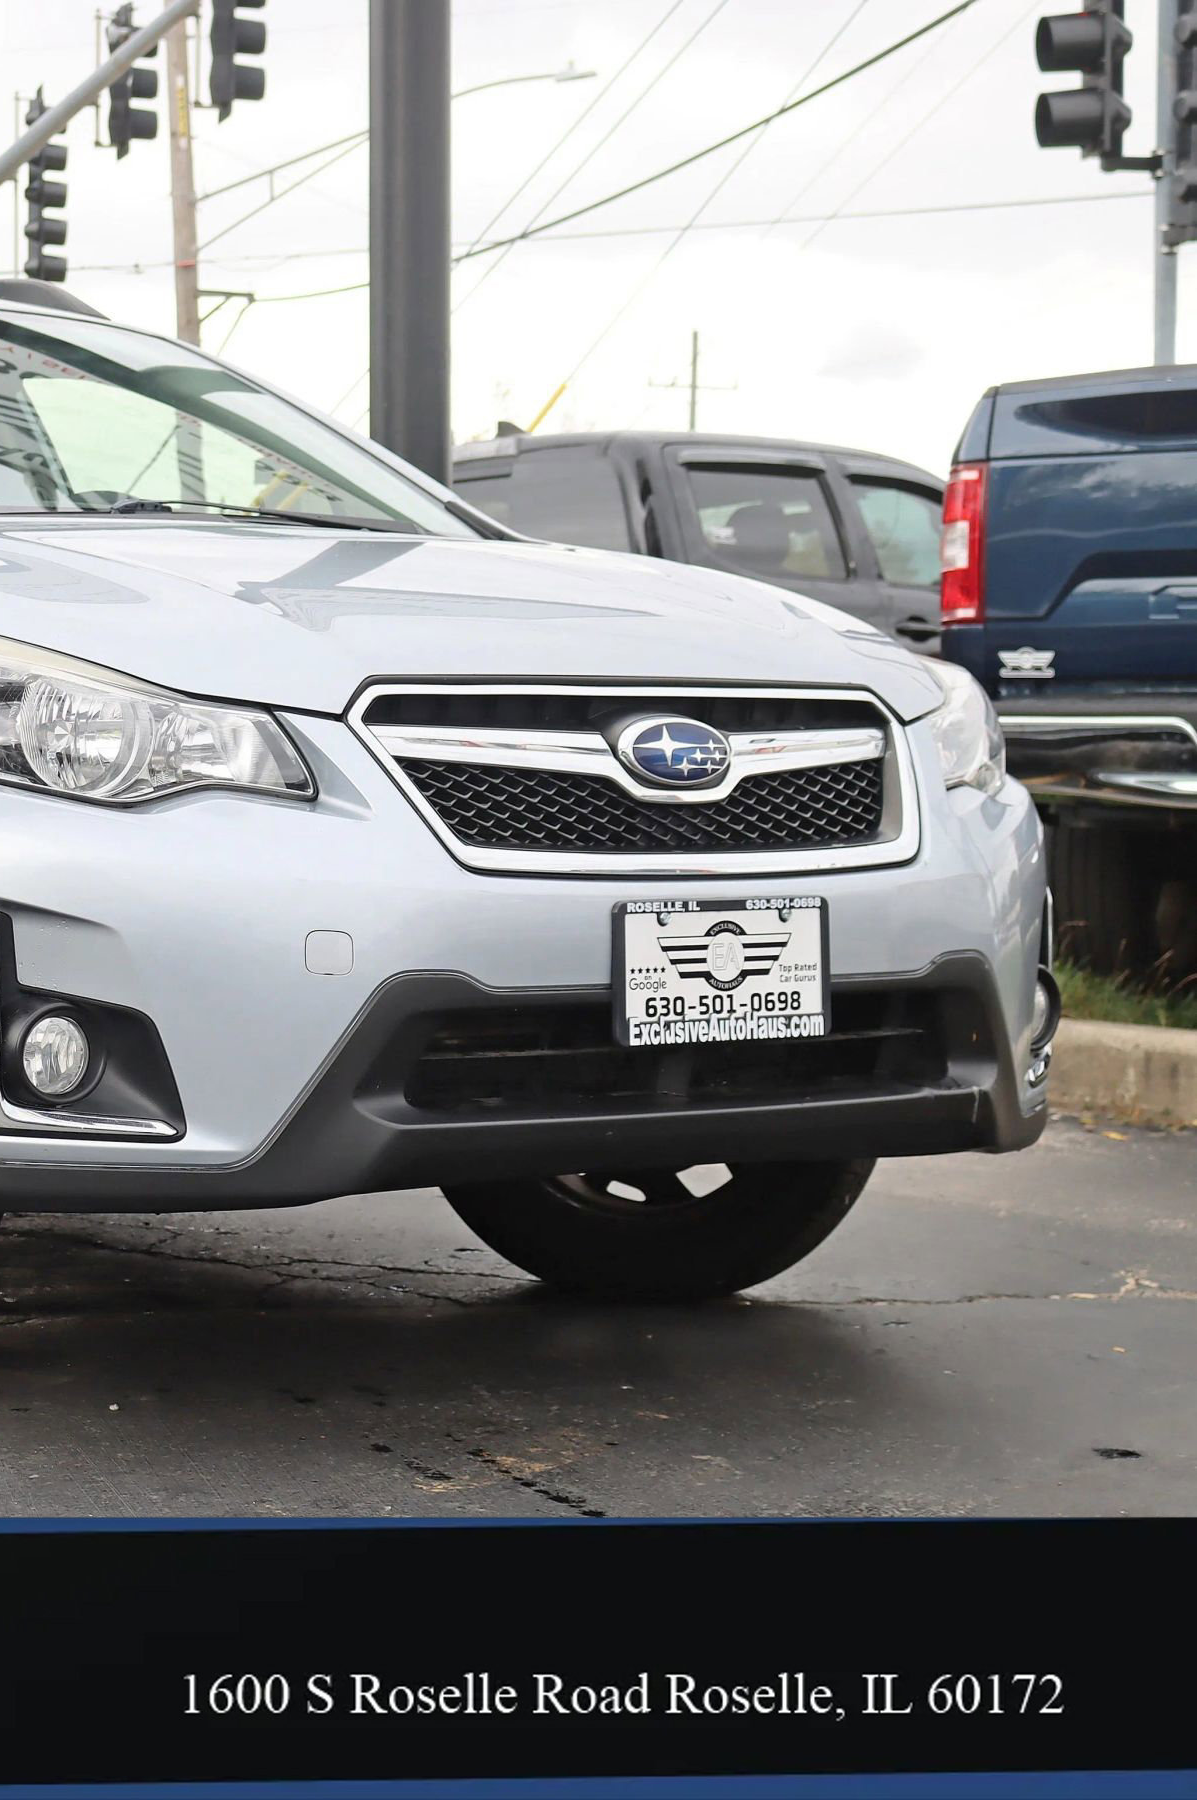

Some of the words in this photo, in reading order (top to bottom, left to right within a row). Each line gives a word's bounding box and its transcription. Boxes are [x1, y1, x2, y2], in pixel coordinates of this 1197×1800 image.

[626, 902, 685, 913] ROSELLE,
[688, 901, 701, 911] IL
[745, 897, 821, 910] 630-501-0698
[778, 964, 793, 974] Top
[794, 963, 818, 971] Rated
[629, 977, 668, 993] Google
[779, 974, 792, 983] Car
[794, 974, 817, 982] Gurus
[645, 991, 802, 1017] 630-501-0698
[628, 1011, 825, 1047] ExclusiveAutoHaus.com
